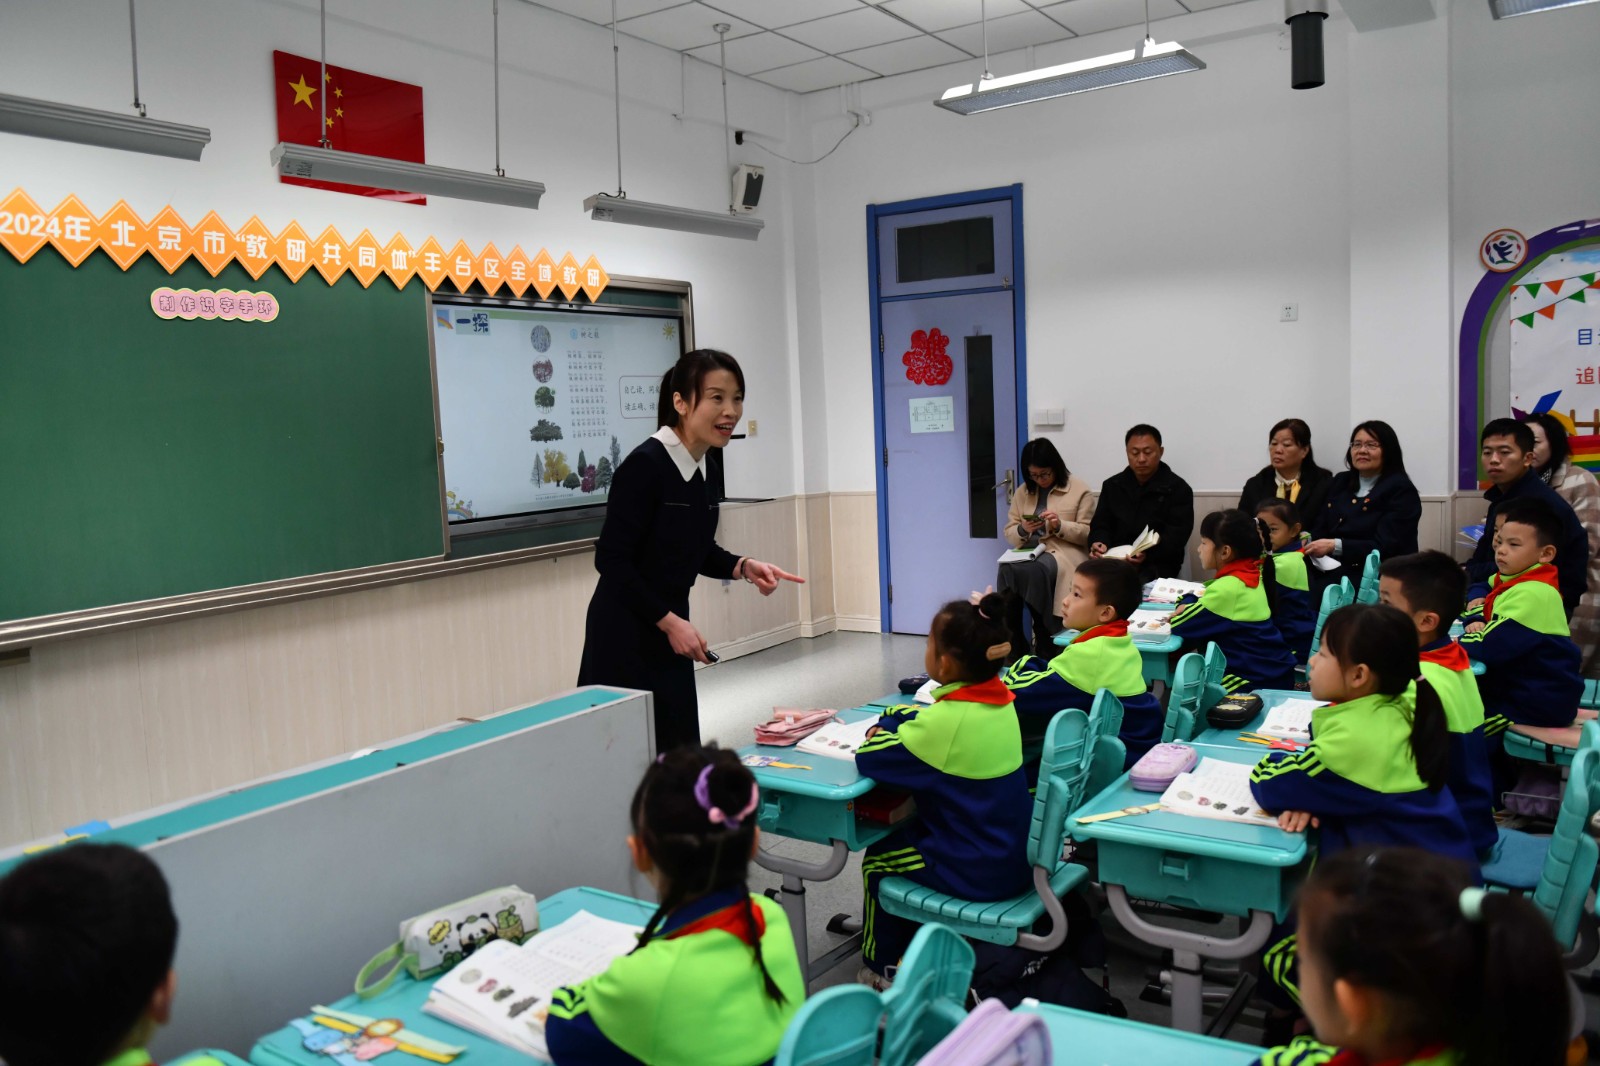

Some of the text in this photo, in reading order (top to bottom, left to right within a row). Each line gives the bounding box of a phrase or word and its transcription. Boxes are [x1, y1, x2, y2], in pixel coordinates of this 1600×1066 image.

[159, 295, 273, 315] 制作识字手环
[456, 313, 489, 333] 一探
[1578, 328, 1600, 346] 目
[1575, 366, 1600, 385] 追
